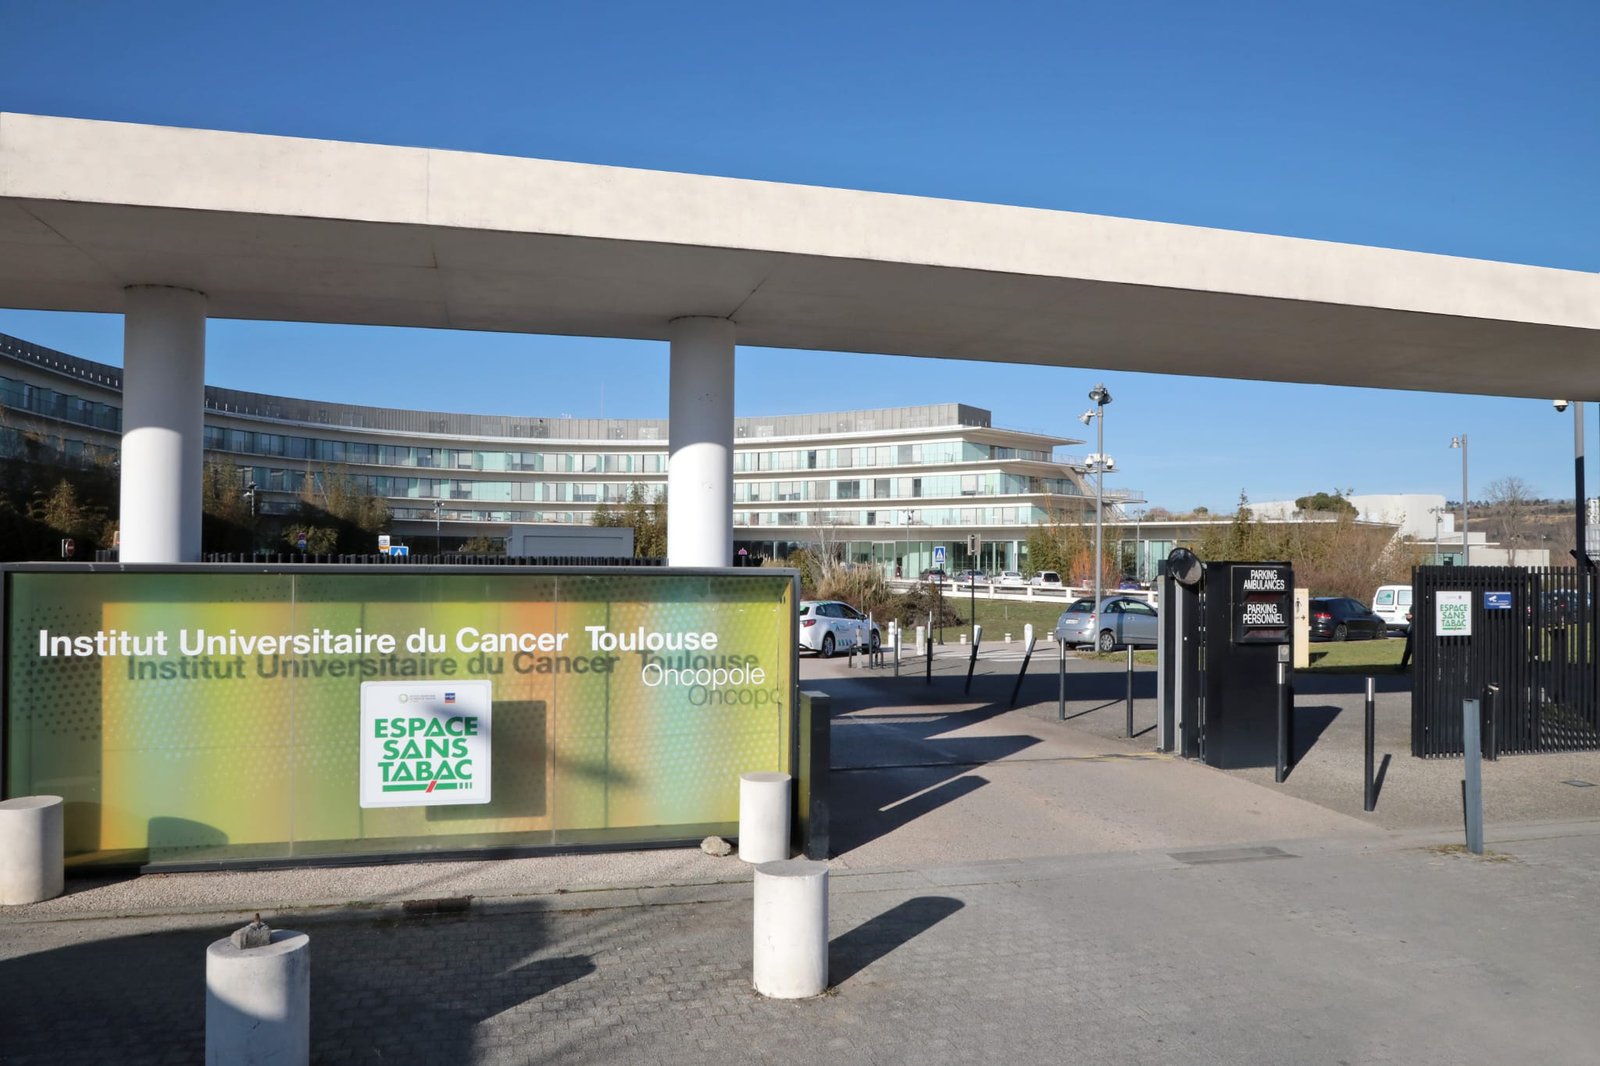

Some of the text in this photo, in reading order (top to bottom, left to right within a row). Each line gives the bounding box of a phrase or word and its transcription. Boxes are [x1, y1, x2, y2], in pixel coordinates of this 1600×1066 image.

[1250, 569, 1278, 580] PARKING
[1243, 580, 1285, 590] AMBULANCES
[1247, 604, 1278, 614] PARKING
[1440, 604, 1468, 612] ESPACE
[1242, 614, 1285, 624] PERSONNEL
[1442, 612, 1466, 620] SANS
[39, 625, 718, 657] Institut Universitaire du Cancer Toulouse
[641, 662, 766, 691] Oncopole
[374, 716, 478, 739] ESPACE
[382, 737, 469, 761] SANS
[377, 758, 473, 783] TABAC
